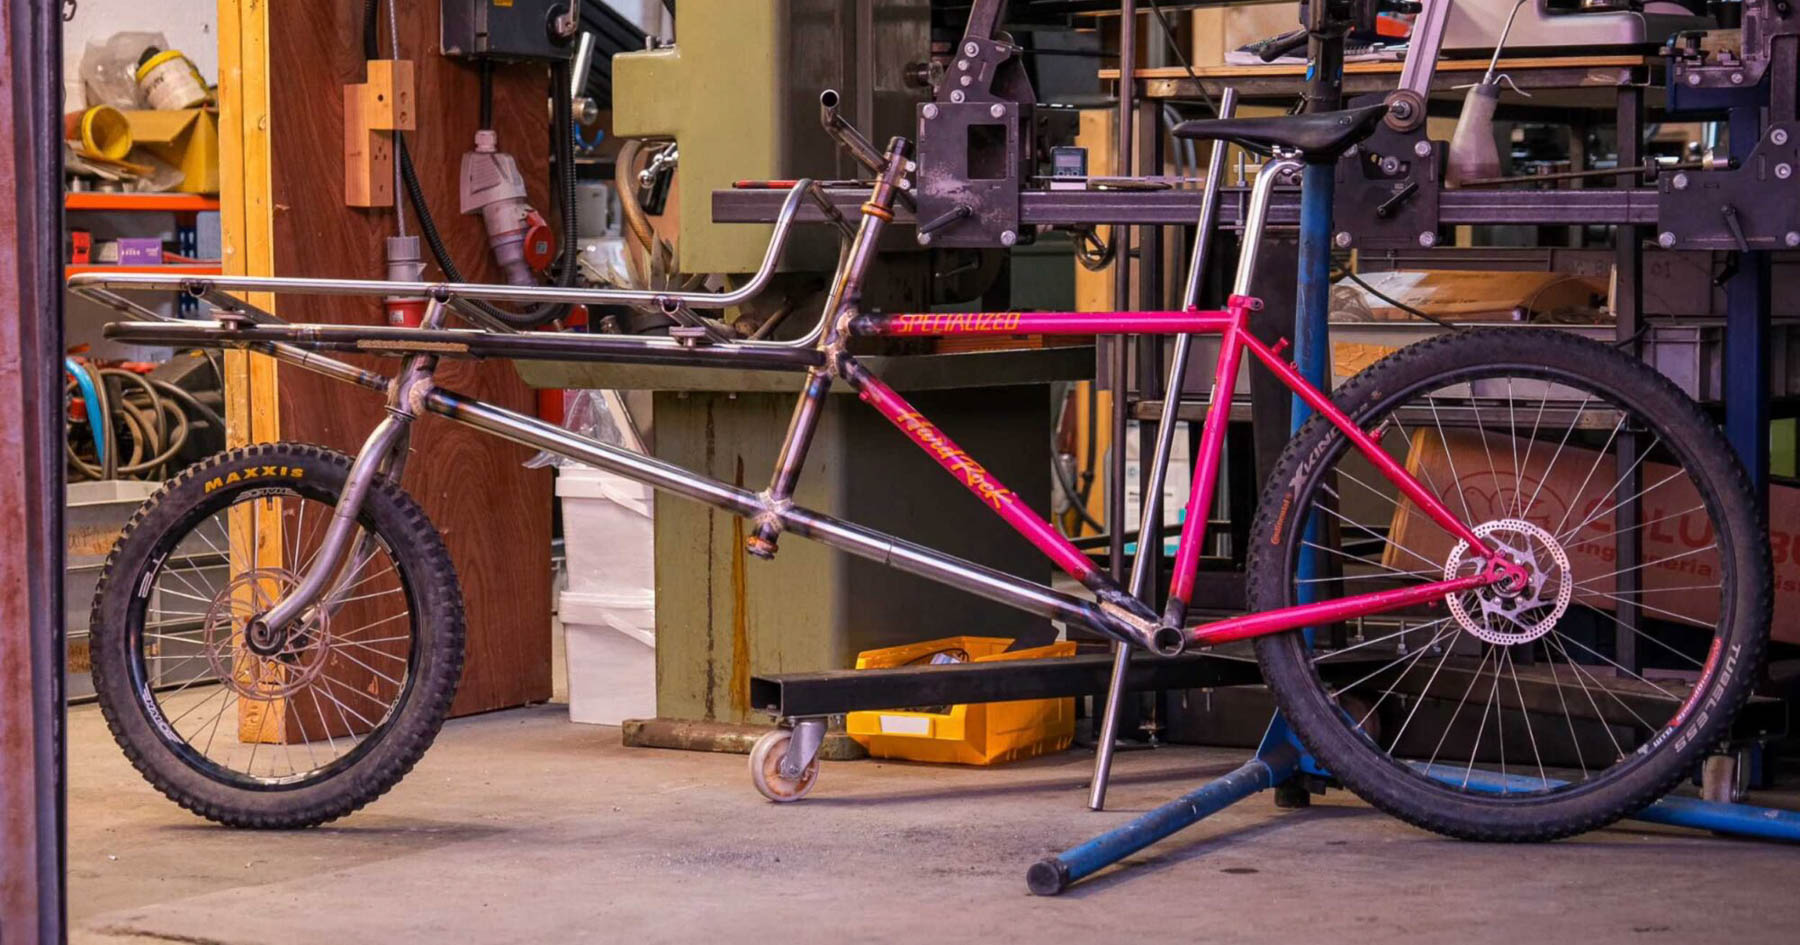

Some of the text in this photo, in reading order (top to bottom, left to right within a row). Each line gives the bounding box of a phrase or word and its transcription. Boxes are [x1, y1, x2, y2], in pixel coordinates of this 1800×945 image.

[897, 312, 1021, 334] SPECIALIZED
[204, 465, 305, 493] MAXXIS
[1674, 643, 1742, 754] TUBELESS
